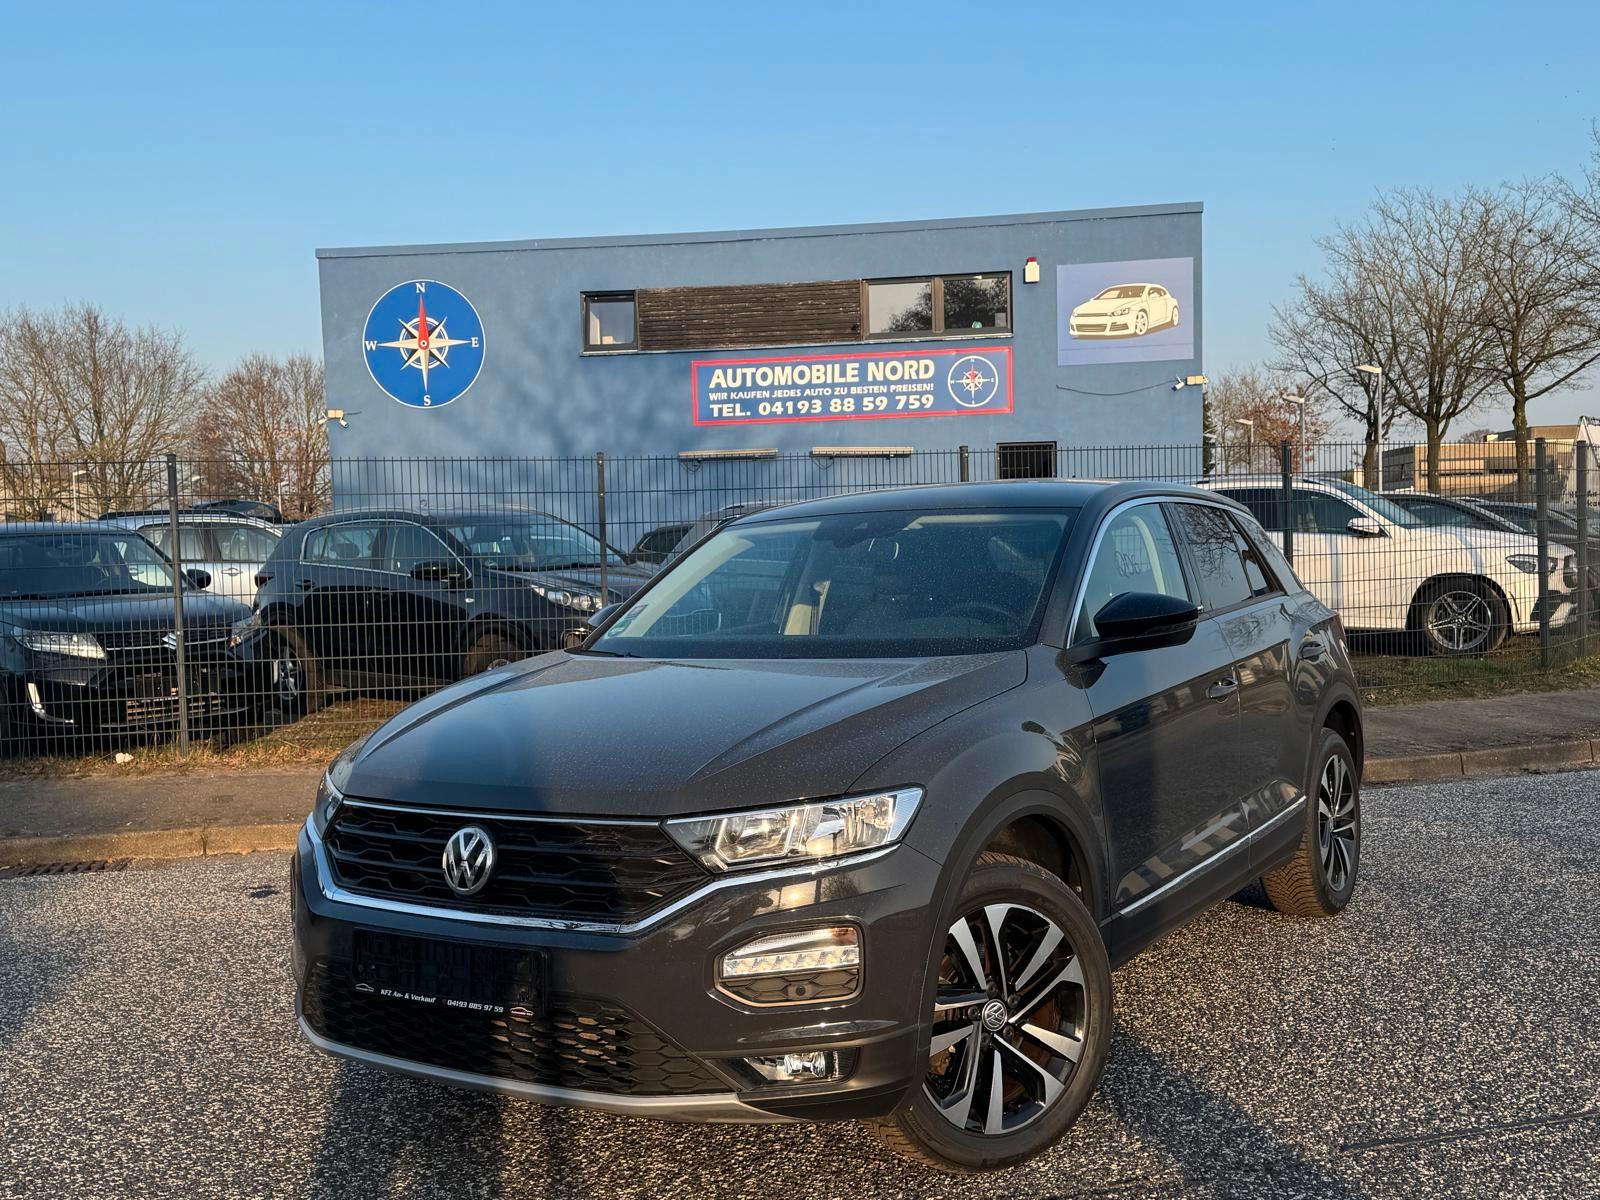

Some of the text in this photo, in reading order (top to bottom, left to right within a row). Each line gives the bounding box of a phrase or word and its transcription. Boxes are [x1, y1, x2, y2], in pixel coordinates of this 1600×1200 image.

[415, 283, 426, 293] N
[365, 340, 378, 351] W
[470, 337, 479, 347] E
[708, 359, 936, 388] AUTOMOBILE NORD
[708, 383, 935, 401] WIR KAUFEN JEDES AUTO ZU BESTEN PREISEN!
[423, 394, 432, 406] S
[709, 394, 935, 418] TEL. 04193 88 59 759
[380, 989, 392, 997] KFZ
[411, 993, 436, 1003] Verkauf
[447, 999, 468, 1008] 04193
[468, 1002, 482, 1010] 885
